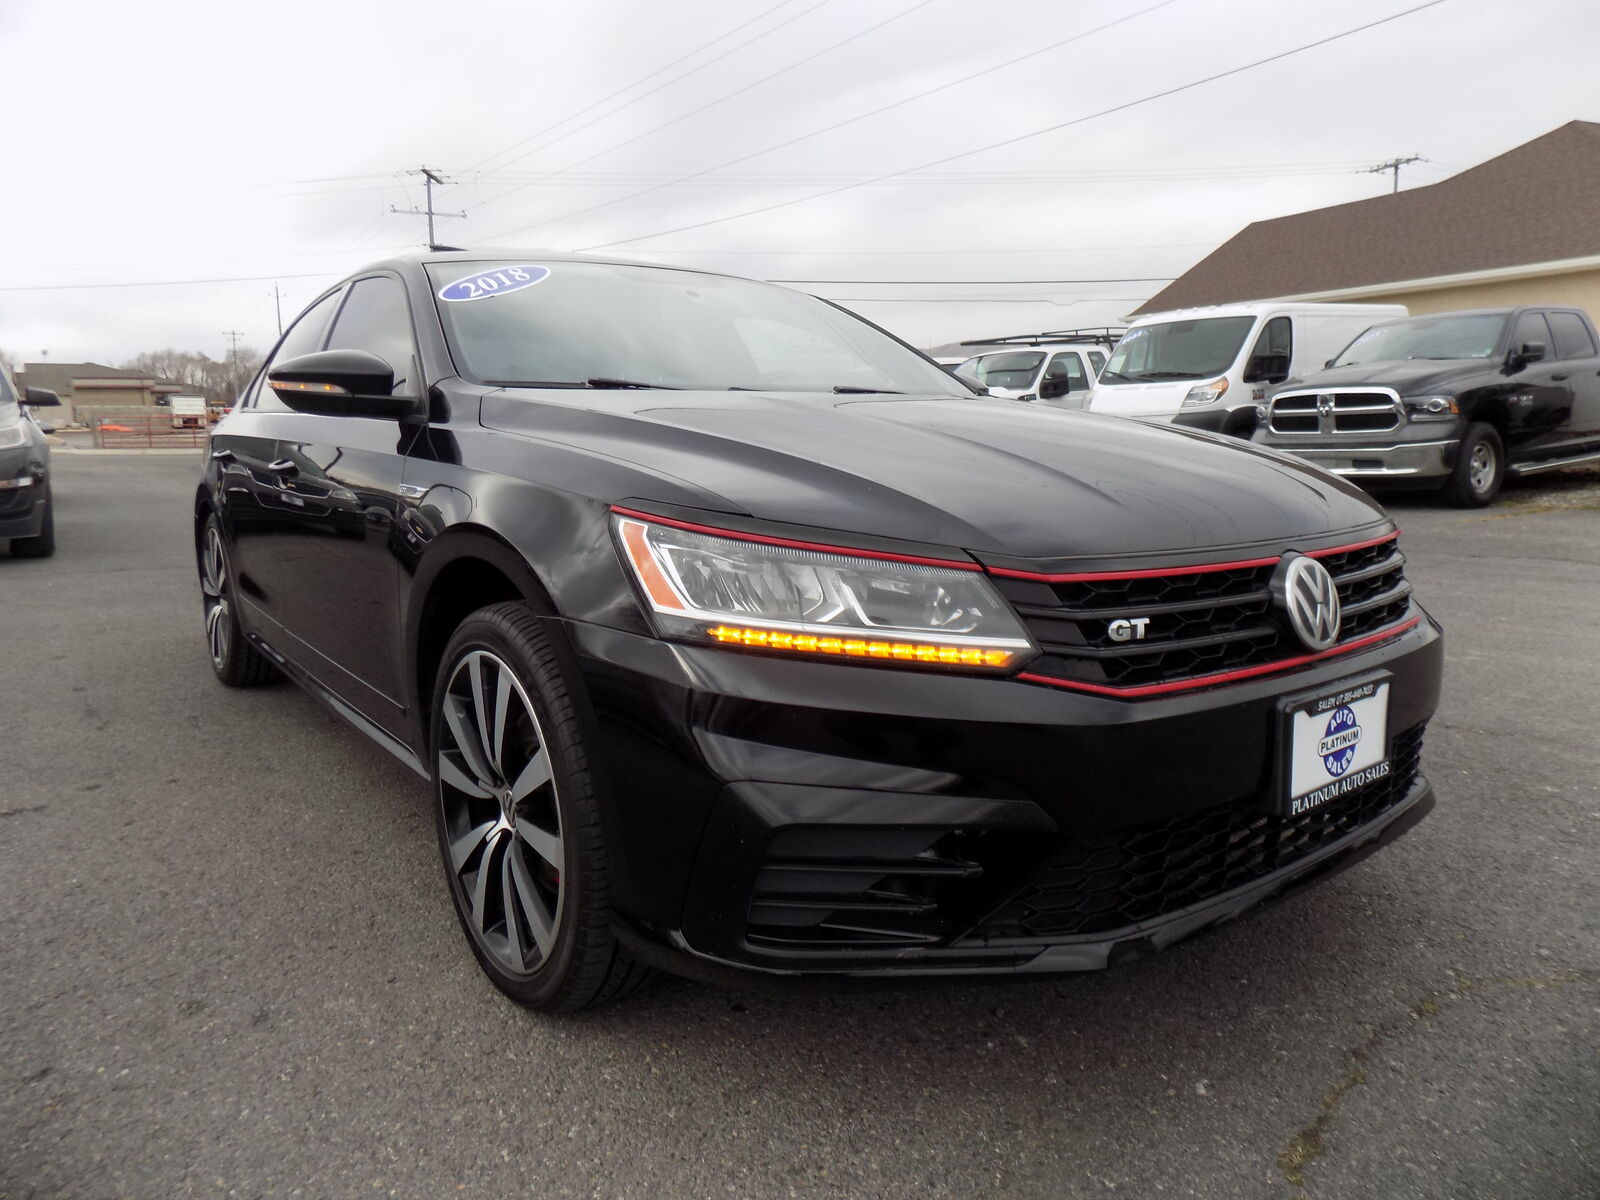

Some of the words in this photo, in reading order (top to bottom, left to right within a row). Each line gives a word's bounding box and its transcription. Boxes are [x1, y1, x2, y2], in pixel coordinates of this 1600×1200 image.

[459, 267, 531, 298] 2018
[1108, 617, 1151, 642] GT
[1330, 709, 1354, 731] AUTO
[1320, 729, 1360, 753] PLATINUM
[1326, 749, 1353, 774] SALES
[1292, 783, 1339, 815] PLATINUM
[1341, 772, 1365, 794] AUTO
[1366, 761, 1390, 782] SALES
